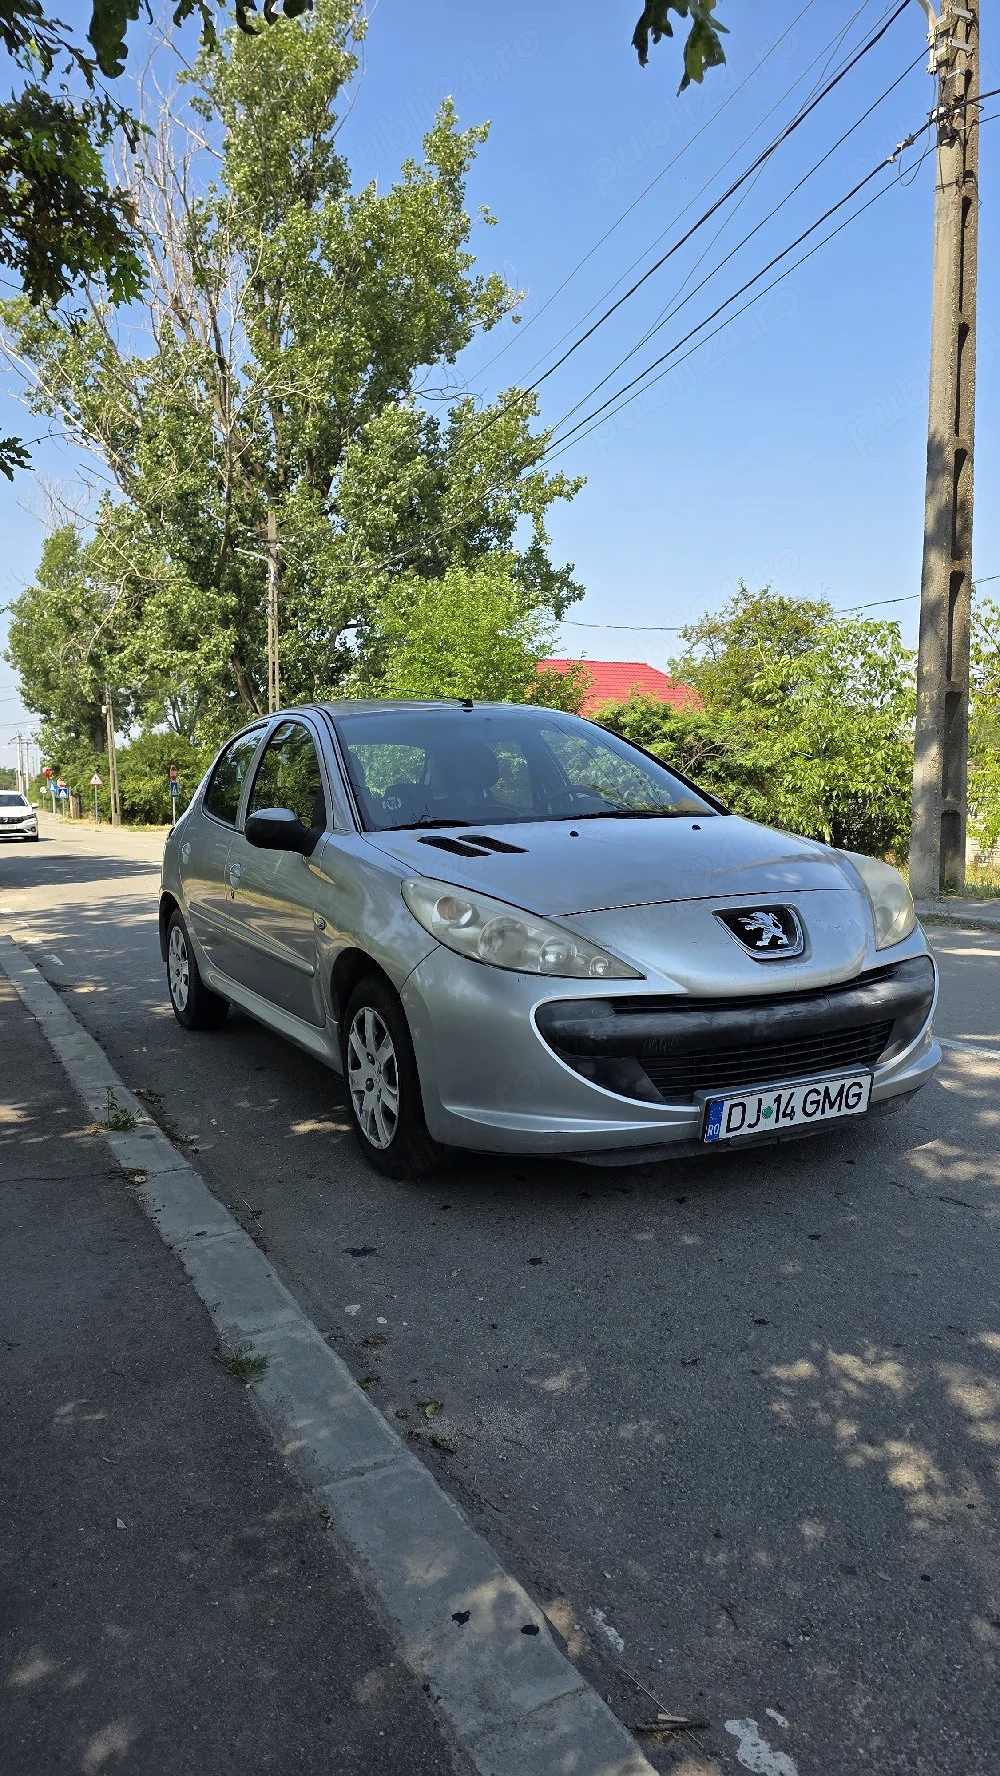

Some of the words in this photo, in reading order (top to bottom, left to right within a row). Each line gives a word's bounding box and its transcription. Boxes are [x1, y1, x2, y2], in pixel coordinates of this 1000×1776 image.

[725, 1097, 763, 1133] DJ
[772, 1091, 796, 1124] 14
[802, 1081, 863, 1118] GMG
[707, 1123, 720, 1137] RO
